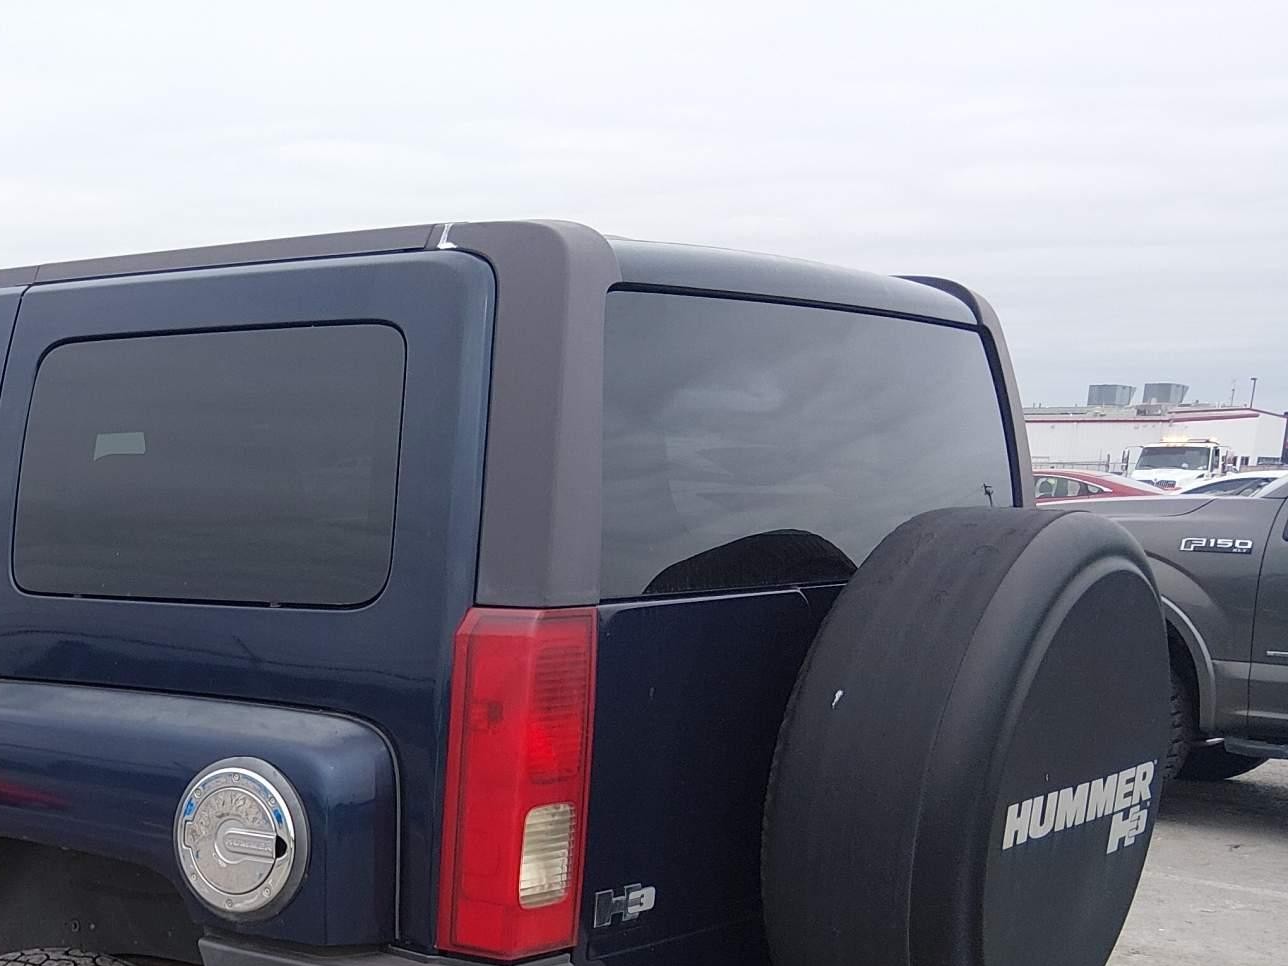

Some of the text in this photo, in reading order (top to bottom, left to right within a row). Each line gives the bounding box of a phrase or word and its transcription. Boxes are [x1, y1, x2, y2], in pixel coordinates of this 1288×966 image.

[1002, 759, 1154, 850] HUMMER
[1106, 805, 1148, 854] H3
[593, 883, 656, 928] H3
